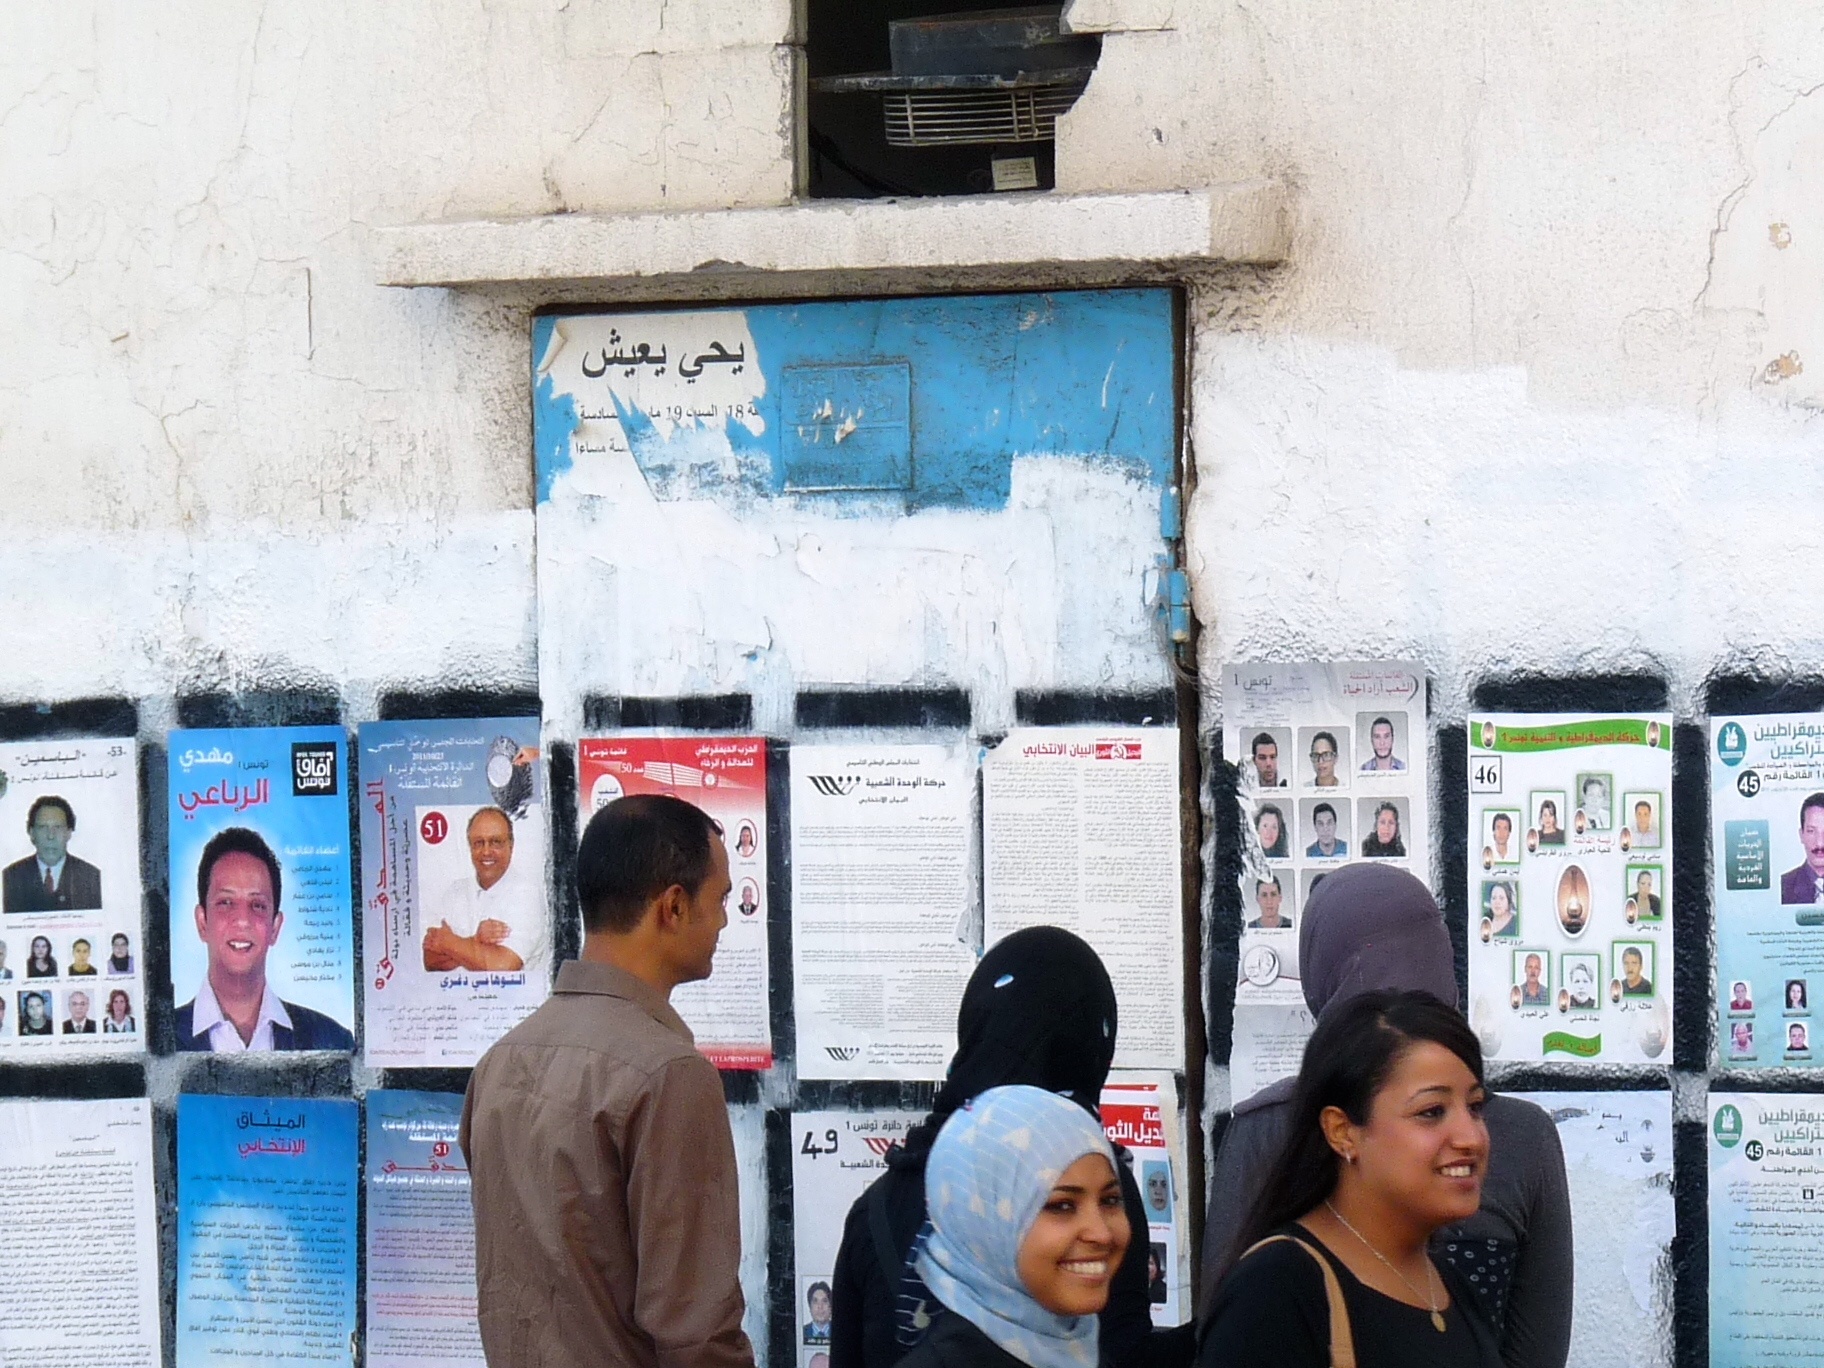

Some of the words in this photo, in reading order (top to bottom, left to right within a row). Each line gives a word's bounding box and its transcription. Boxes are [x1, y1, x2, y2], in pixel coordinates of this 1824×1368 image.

[582, 328, 667, 378] يعيش
[666, 405, 682, 420] 19
[1243, 675, 1272, 691] تونس
[1023, 743, 1067, 758] الانتخابي
[1070, 743, 1095, 758] البيان
[179, 747, 233, 773] مهدي
[621, 763, 632, 773] 50
[1474, 764, 1497, 785] 46
[297, 777, 331, 789] تونس
[865, 776, 894, 788] الشعبية
[897, 776, 922, 789] الوحدة
[924, 778, 946, 788] حركة
[1739, 775, 1759, 793] 45
[178, 778, 268, 820] الرباعي
[424, 819, 443, 838] 51
[236, 1110, 305, 1129] الميثاق
[853, 1121, 877, 1132] تونس
[435, 1145, 447, 1154] 51
[801, 1129, 838, 1160] 49
[1746, 1144, 1763, 1157] 45
[1766, 1149, 1784, 1159] رقم
[1785, 1148, 1814, 1157] القائمة
